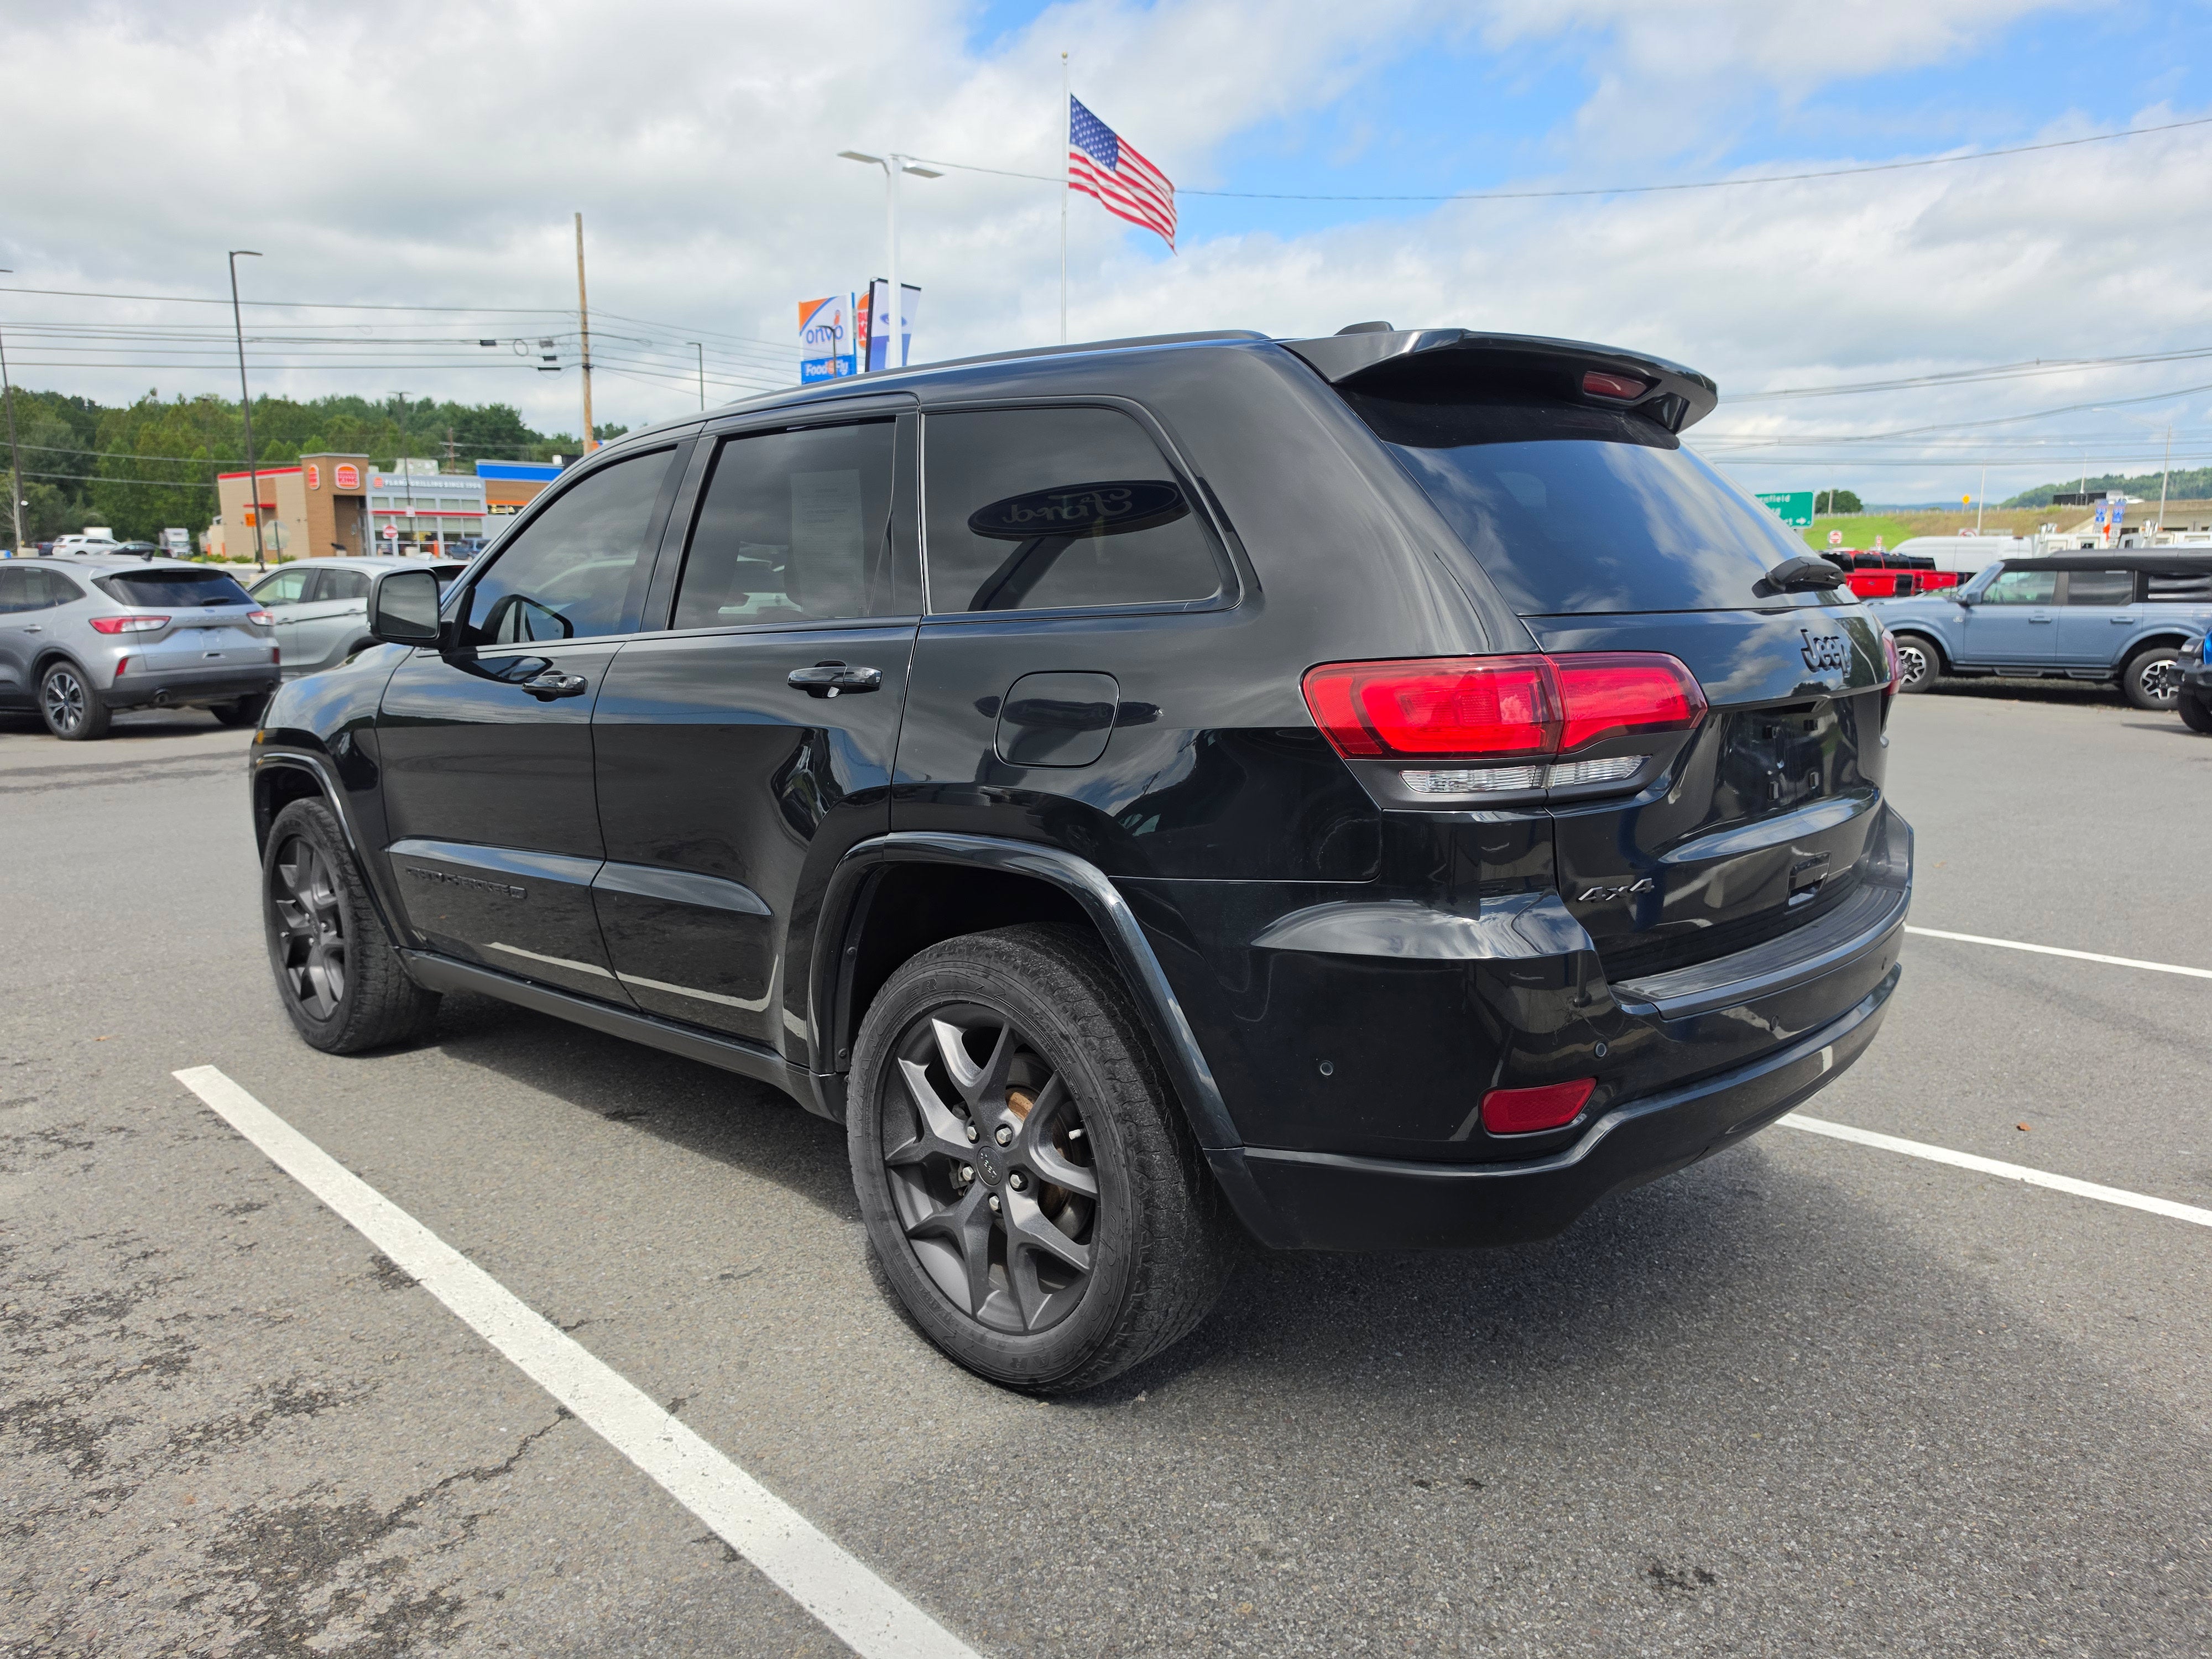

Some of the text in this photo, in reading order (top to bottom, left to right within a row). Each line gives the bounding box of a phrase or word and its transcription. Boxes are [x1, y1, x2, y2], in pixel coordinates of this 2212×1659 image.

[806, 325, 843, 344] onvo
[1800, 629, 1852, 678] Jeep
[1577, 878, 1655, 902] 4x4
